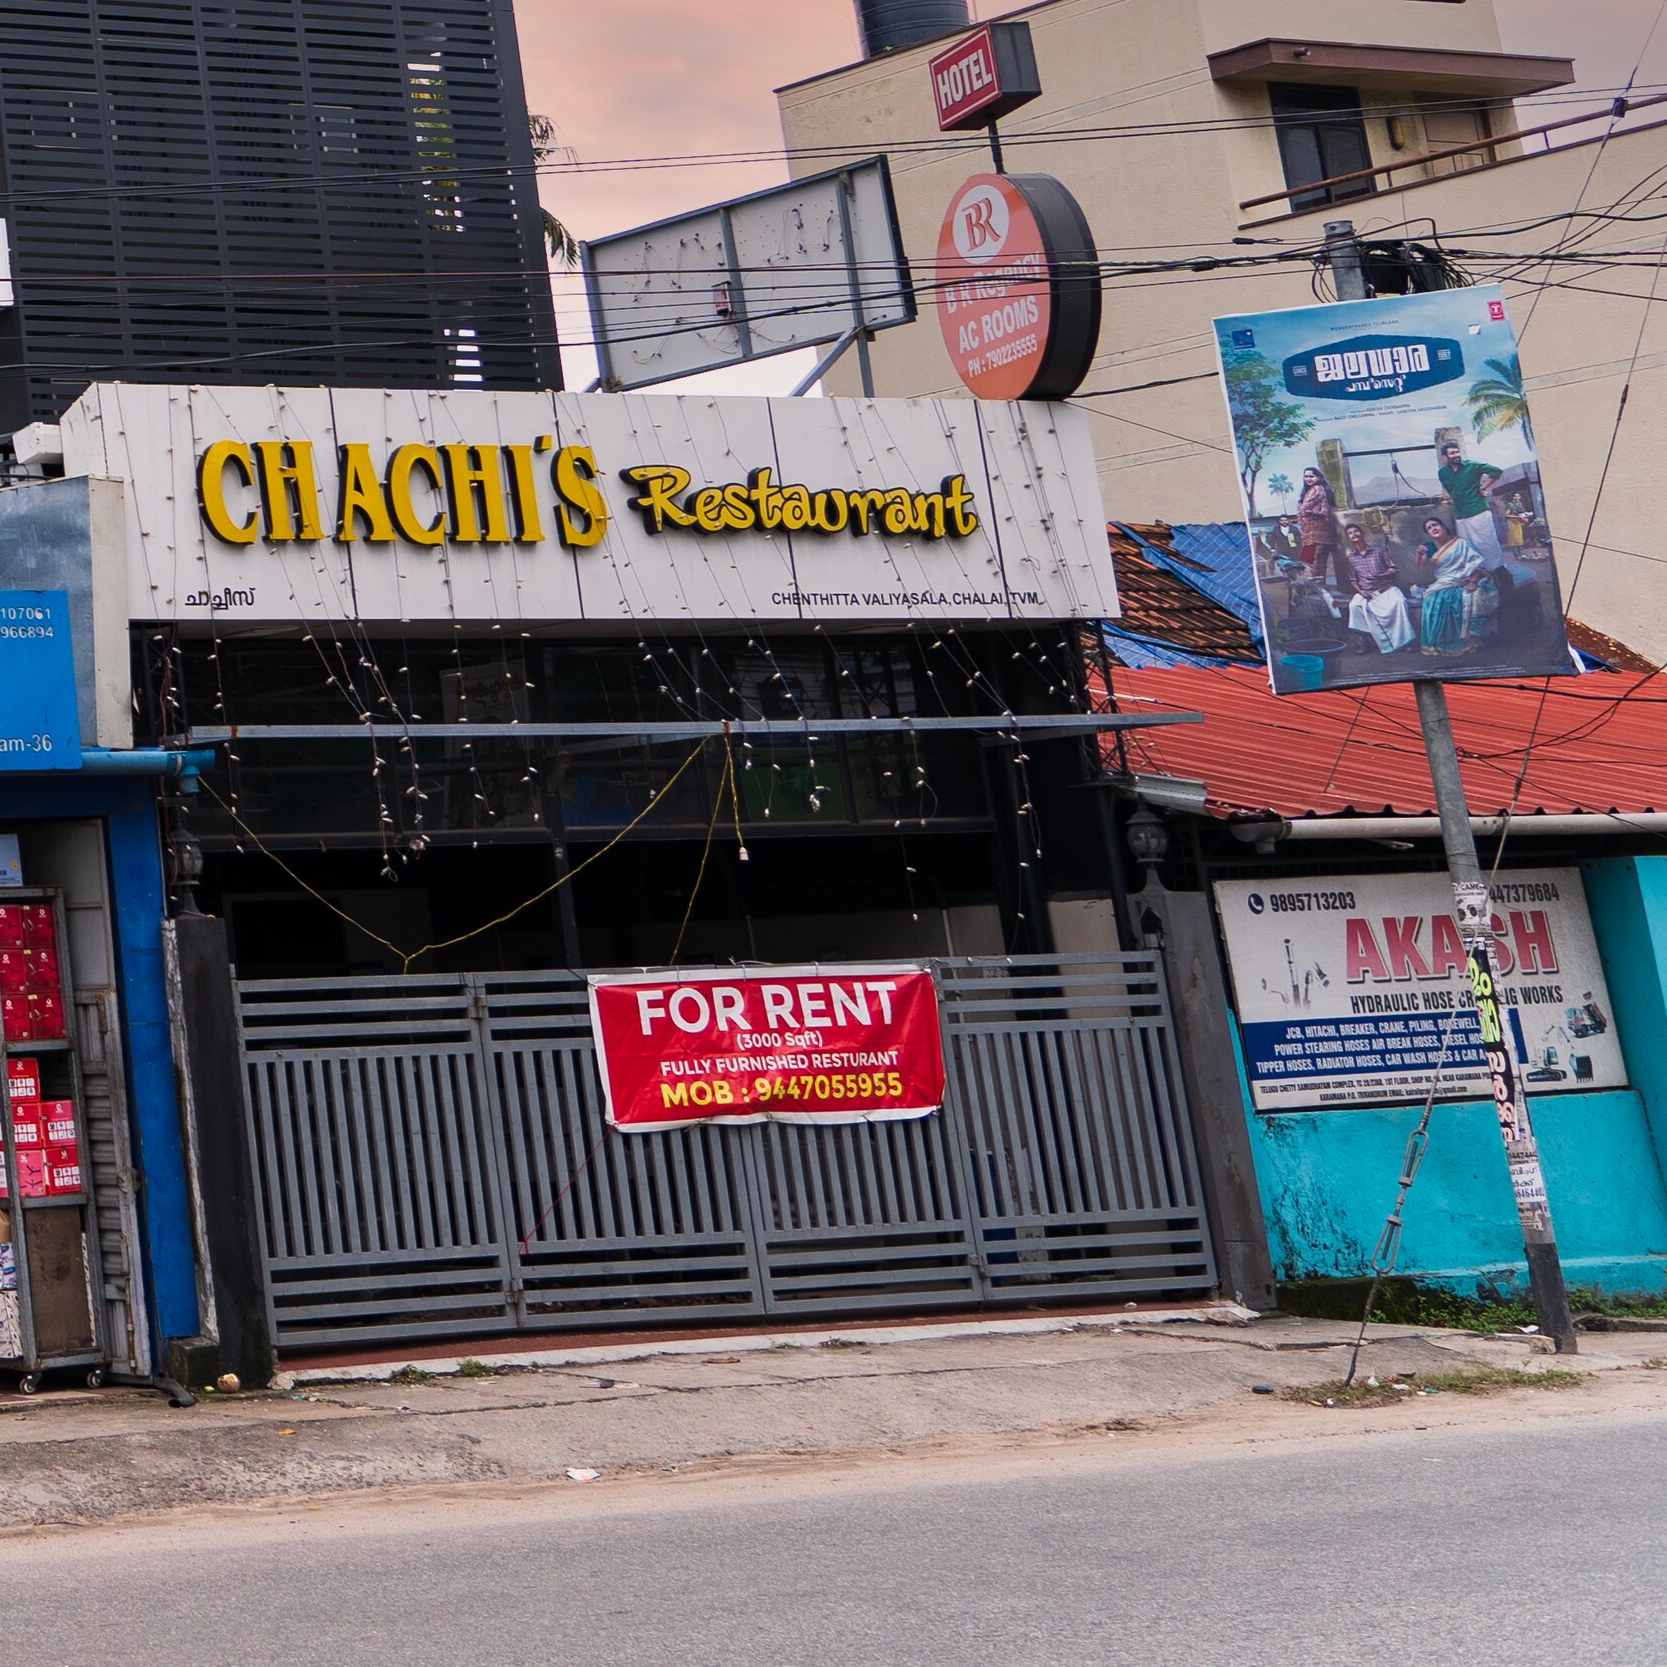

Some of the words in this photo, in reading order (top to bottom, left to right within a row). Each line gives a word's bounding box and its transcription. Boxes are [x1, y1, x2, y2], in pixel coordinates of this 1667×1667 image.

[937, 47, 993, 110] HOTEL
[961, 197, 1001, 252] BR
[958, 324, 979, 354] AC
[982, 295, 1038, 341] ROOMS
[197, 434, 607, 547] CHACHI'S
[619, 466, 981, 540] Restaurant
[771, 591, 858, 607] CHENTHITTA
[1270, 891, 1355, 912] 9895713203
[1487, 883, 1559, 904] 447379684
[636, 986, 750, 1036] FOR
[760, 981, 897, 1031] RENT
[1350, 992, 1419, 1014] HYDRAULIC
[1421, 990, 1454, 1010] HOSE
[1520, 985, 1563, 1006] WORKS
[736, 1032, 782, 1051] (3000
[784, 1030, 823, 1049] Sqft)
[1274, 1043, 1304, 1056] POWER
[1305, 1041, 1343, 1054] STEARING
[1344, 1039, 1370, 1051] HOSES
[1372, 1037, 1386, 1050] AIR
[1386, 1036, 1412, 1049] BREAK
[660, 1060, 711, 1077] FULLY
[716, 1054, 808, 1074] FURNISHED
[812, 1050, 899, 1069] RESTURANT
[1256, 1060, 1285, 1073] TIPPER
[1316, 1056, 1355, 1069] RADIATOR
[1385, 1053, 1402, 1066] CAR
[1403, 1052, 1426, 1065] WASH
[1454, 1050, 1460, 1061] &
[1461, 1049, 1478, 1061] CAR
[660, 1079, 734, 1109] MOB
[756, 1071, 903, 1103] 9447055955
